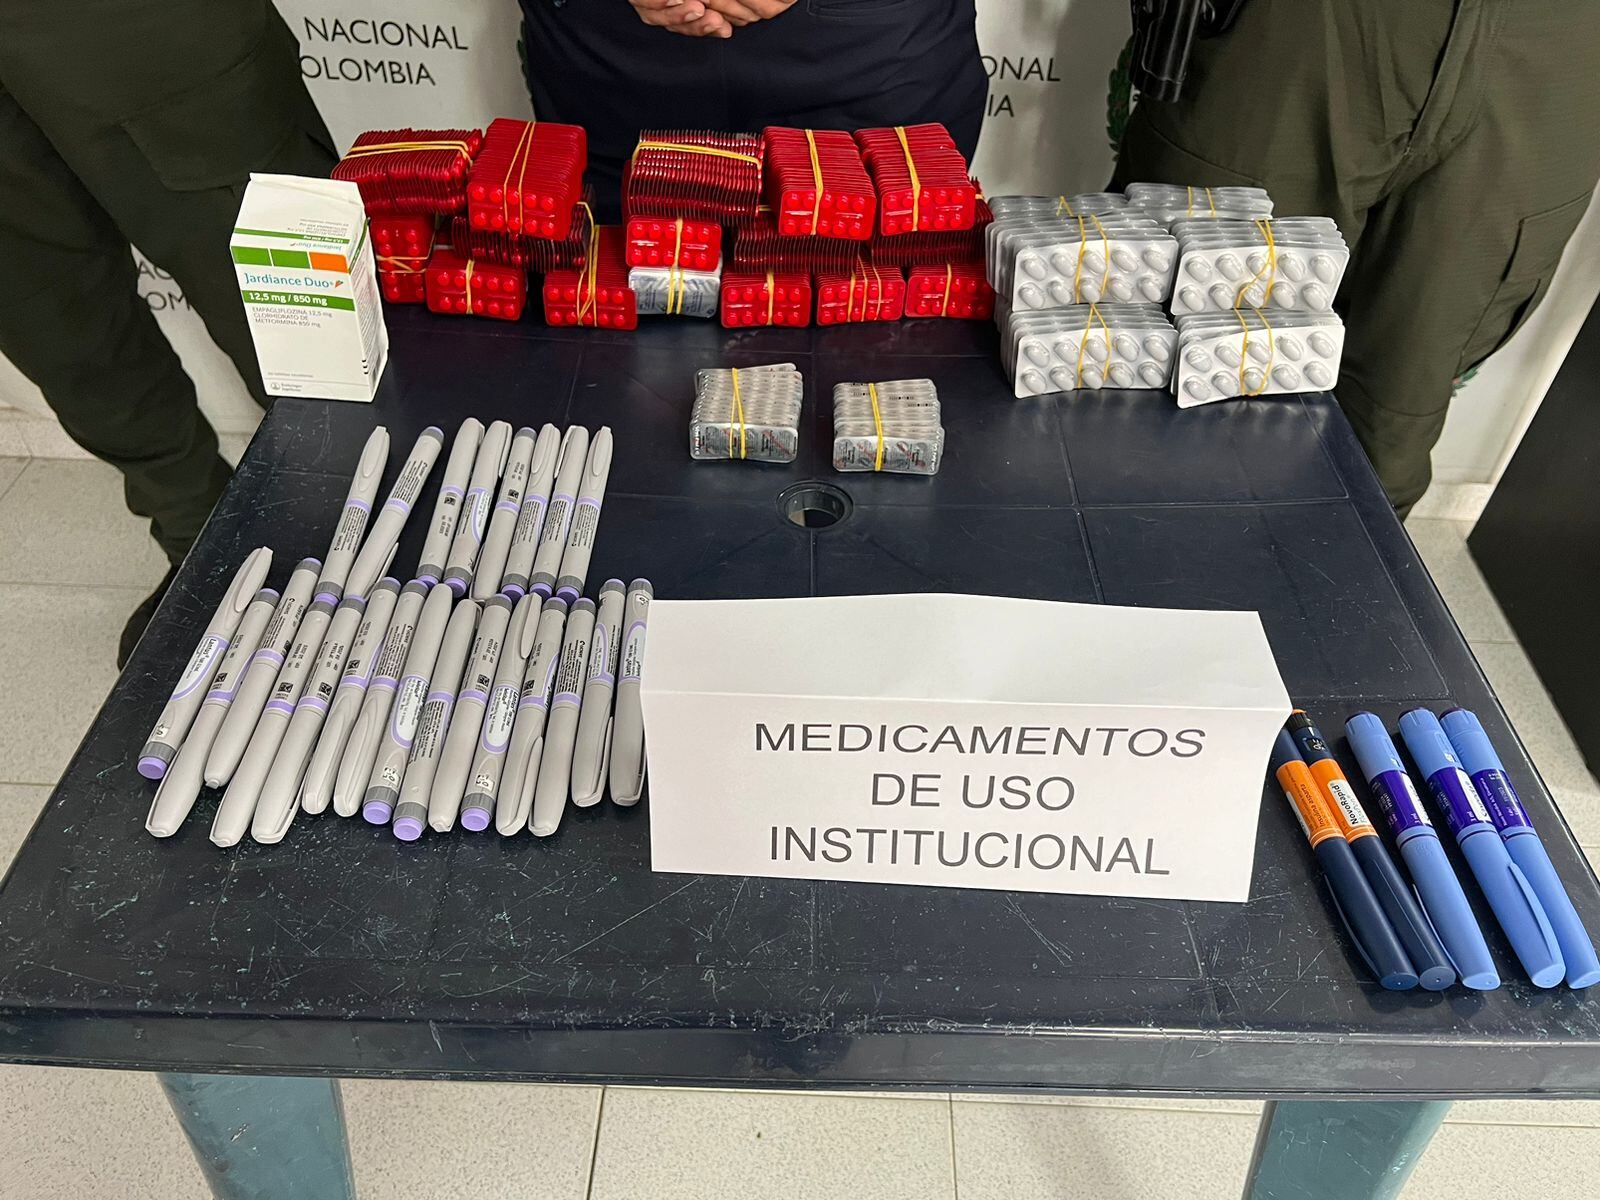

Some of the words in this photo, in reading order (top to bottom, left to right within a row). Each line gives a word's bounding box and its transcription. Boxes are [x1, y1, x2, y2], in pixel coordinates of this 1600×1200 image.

[304, 16, 469, 50] NACIONAL
[300, 55, 436, 86] OLOMBIA
[981, 55, 1061, 82] ONAL
[244, 273, 302, 286] Jardiance
[249, 292, 269, 302] 12,5
[271, 295, 286, 304] mg
[293, 296, 311, 304] 850
[312, 298, 328, 307] mg
[755, 723, 1206, 757] MEDICAMENTOS
[871, 773, 942, 807] DE
[962, 775, 1075, 811] USO
[771, 826, 1170, 875] INSTITUCIONAL
